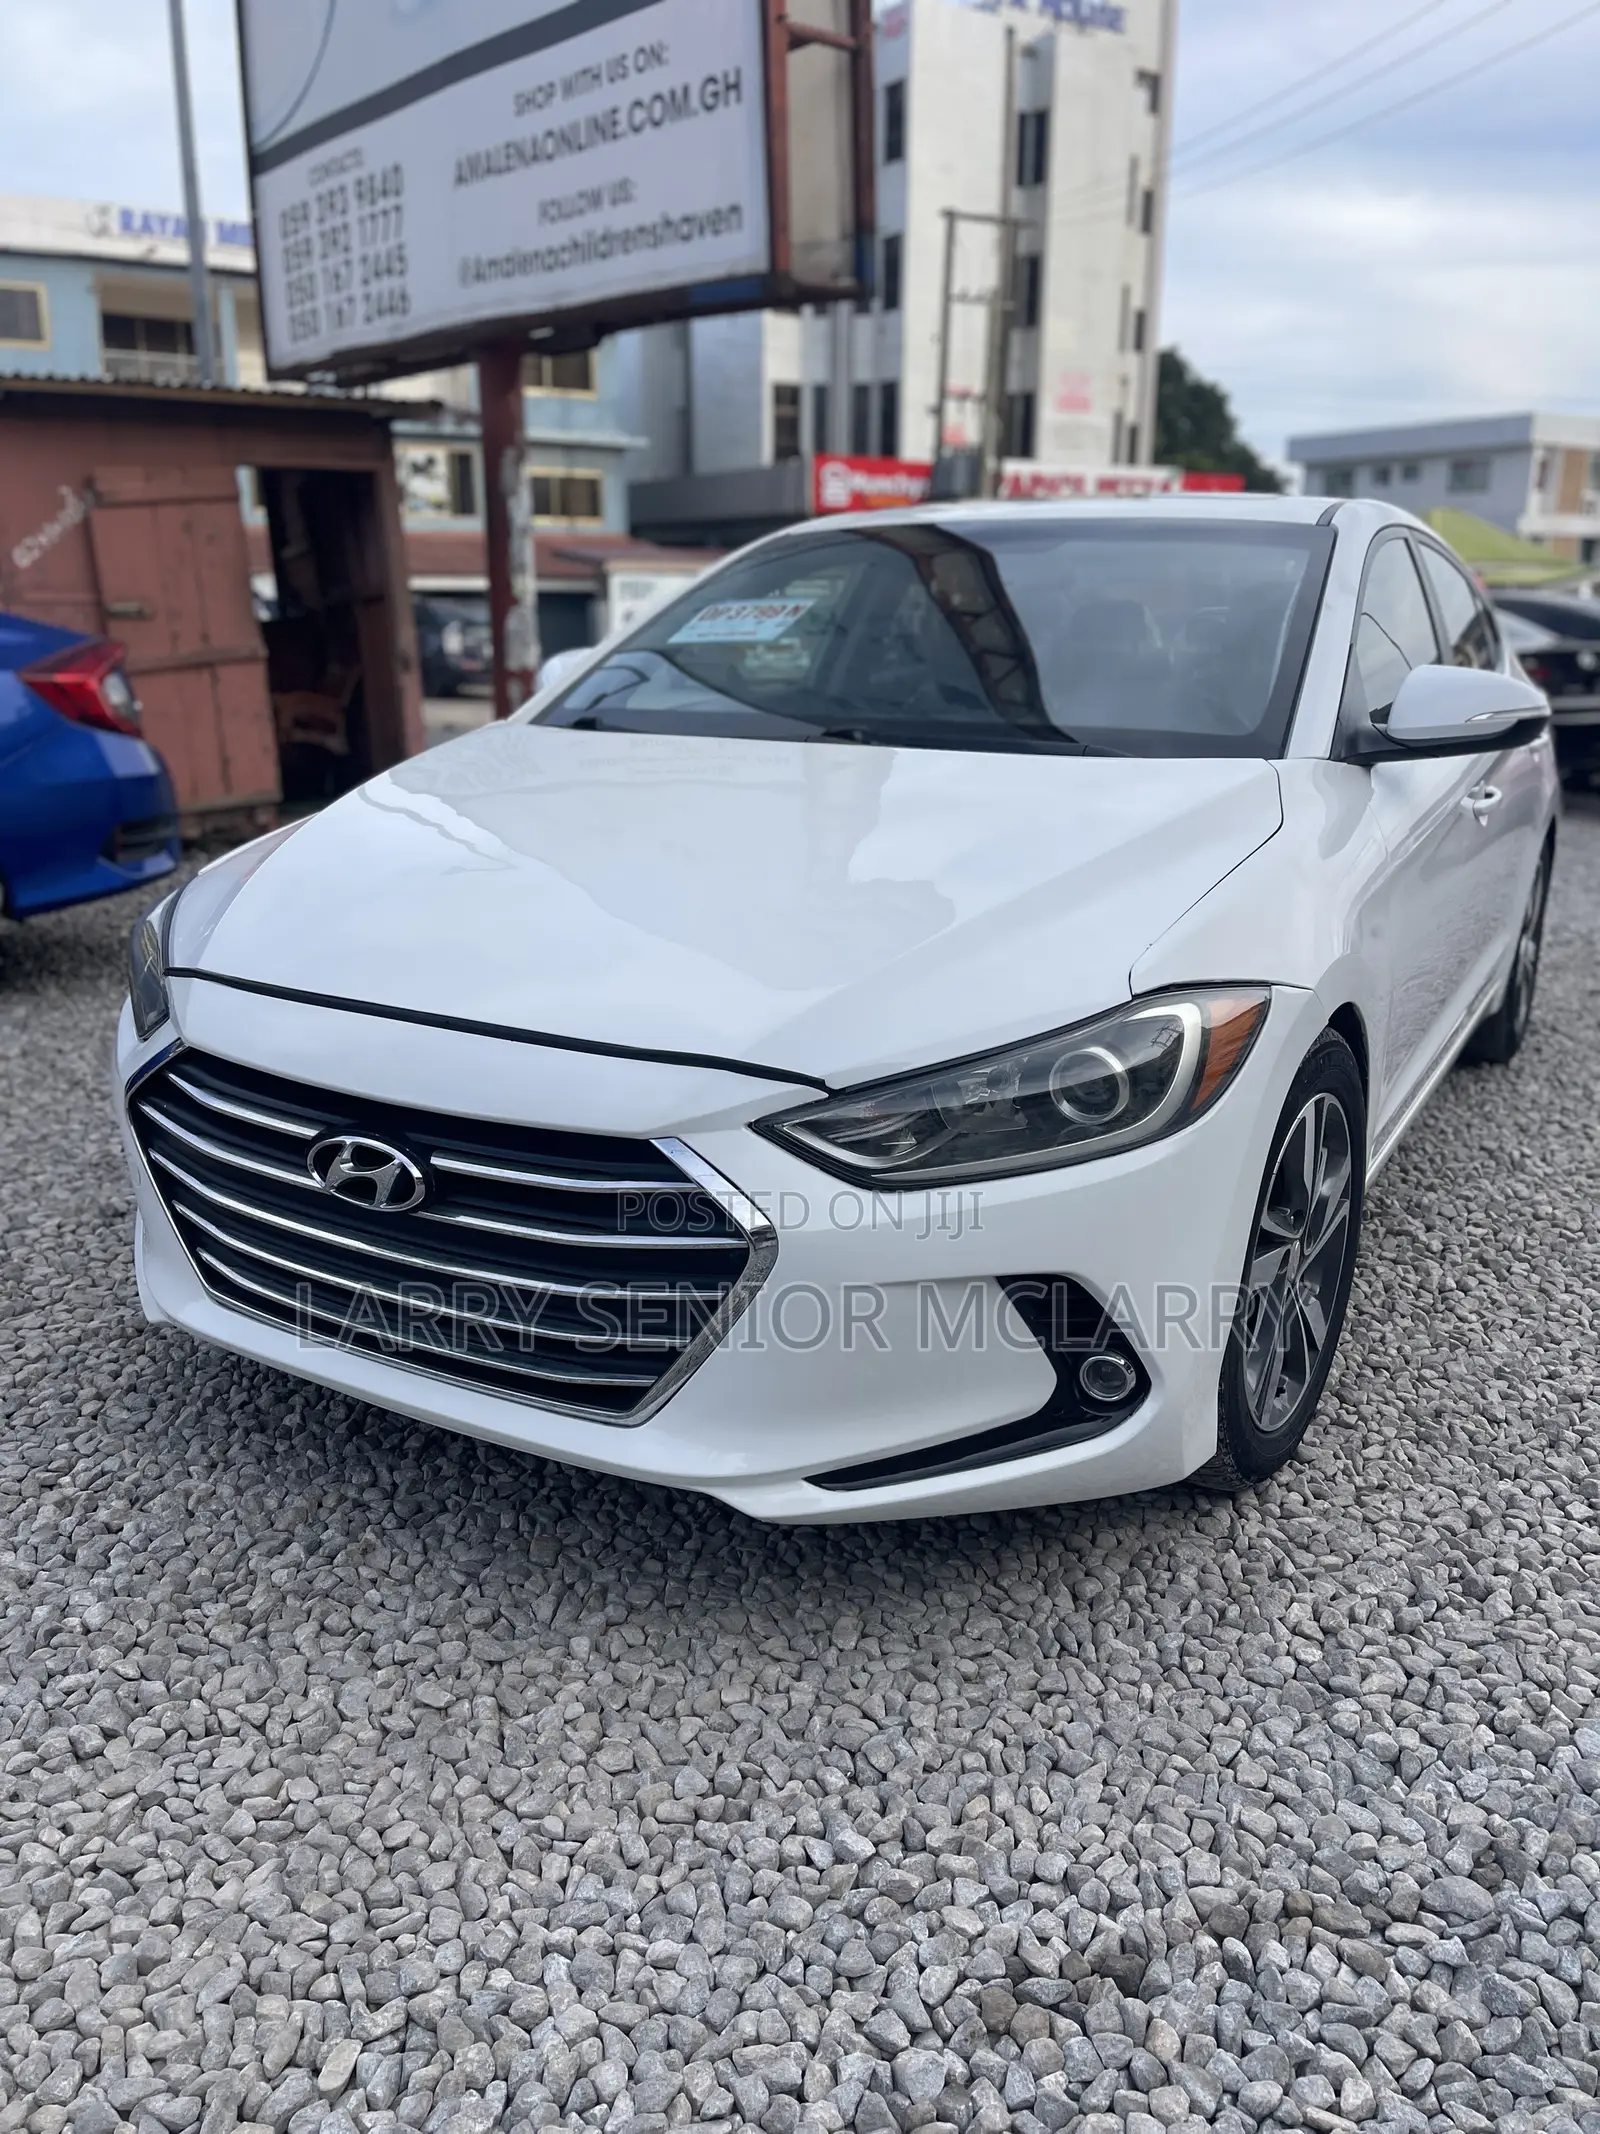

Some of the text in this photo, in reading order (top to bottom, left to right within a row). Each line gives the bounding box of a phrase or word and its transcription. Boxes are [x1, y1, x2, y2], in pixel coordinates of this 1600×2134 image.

[513, 80, 557, 118] SHOP
[558, 61, 602, 102] WITH
[605, 52, 631, 84] US
